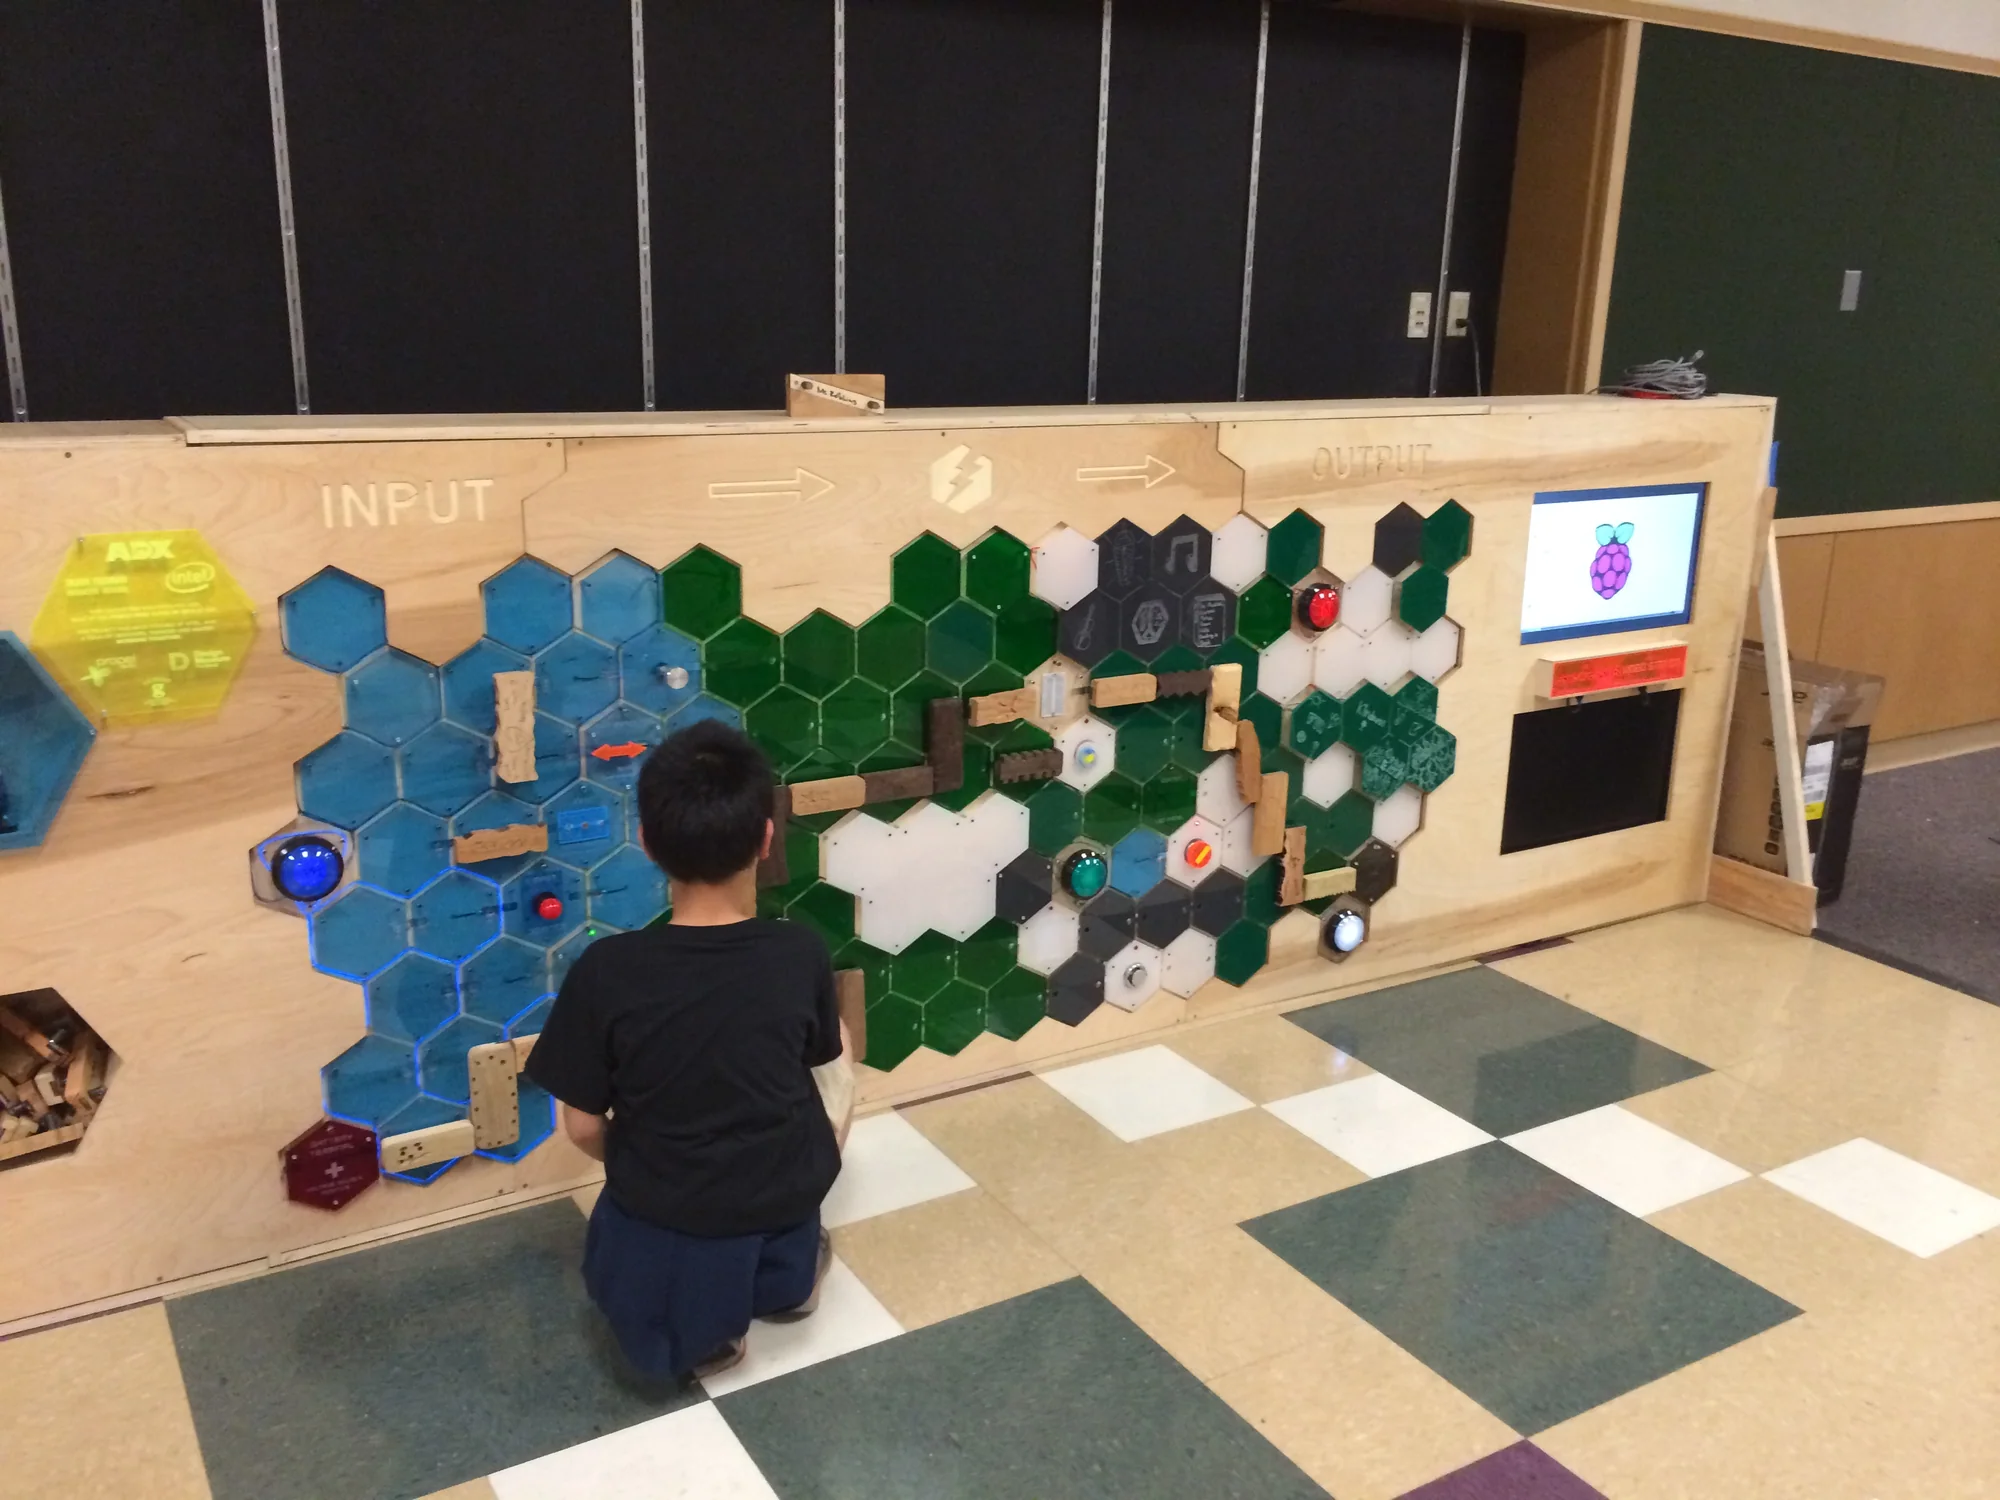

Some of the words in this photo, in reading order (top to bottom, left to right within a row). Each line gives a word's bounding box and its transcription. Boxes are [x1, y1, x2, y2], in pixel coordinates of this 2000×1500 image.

[1312, 443, 1433, 481] OUTPUT
[321, 477, 495, 529] INPUT
[105, 538, 176, 563] ADX
[172, 568, 208, 586] intel
